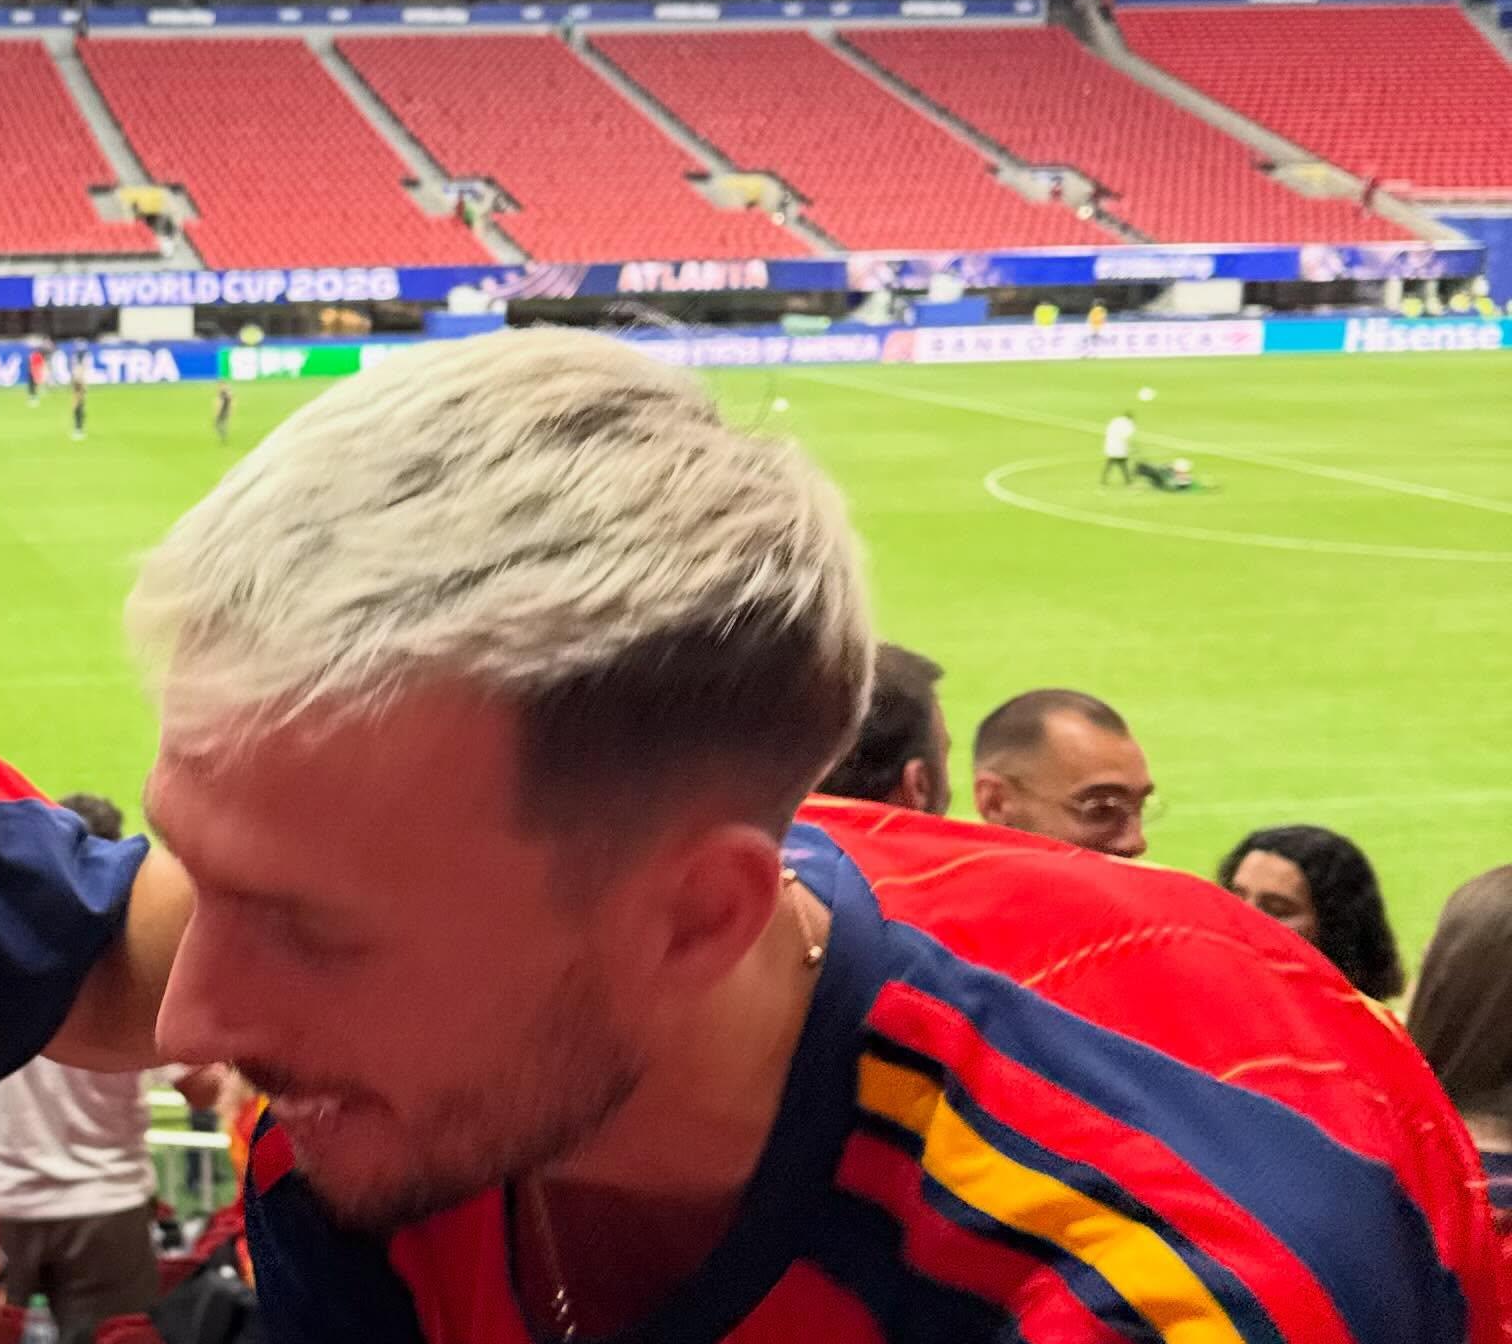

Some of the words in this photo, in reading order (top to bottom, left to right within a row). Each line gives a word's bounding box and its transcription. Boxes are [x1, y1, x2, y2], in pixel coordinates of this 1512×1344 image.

[33, 272, 106, 306] FIFA
[103, 269, 223, 306] WORLD
[221, 268, 288, 305] CUP
[285, 266, 401, 303] 2026
[618, 260, 768, 293] ATLANTA
[1343, 316, 1505, 353] Hisense
